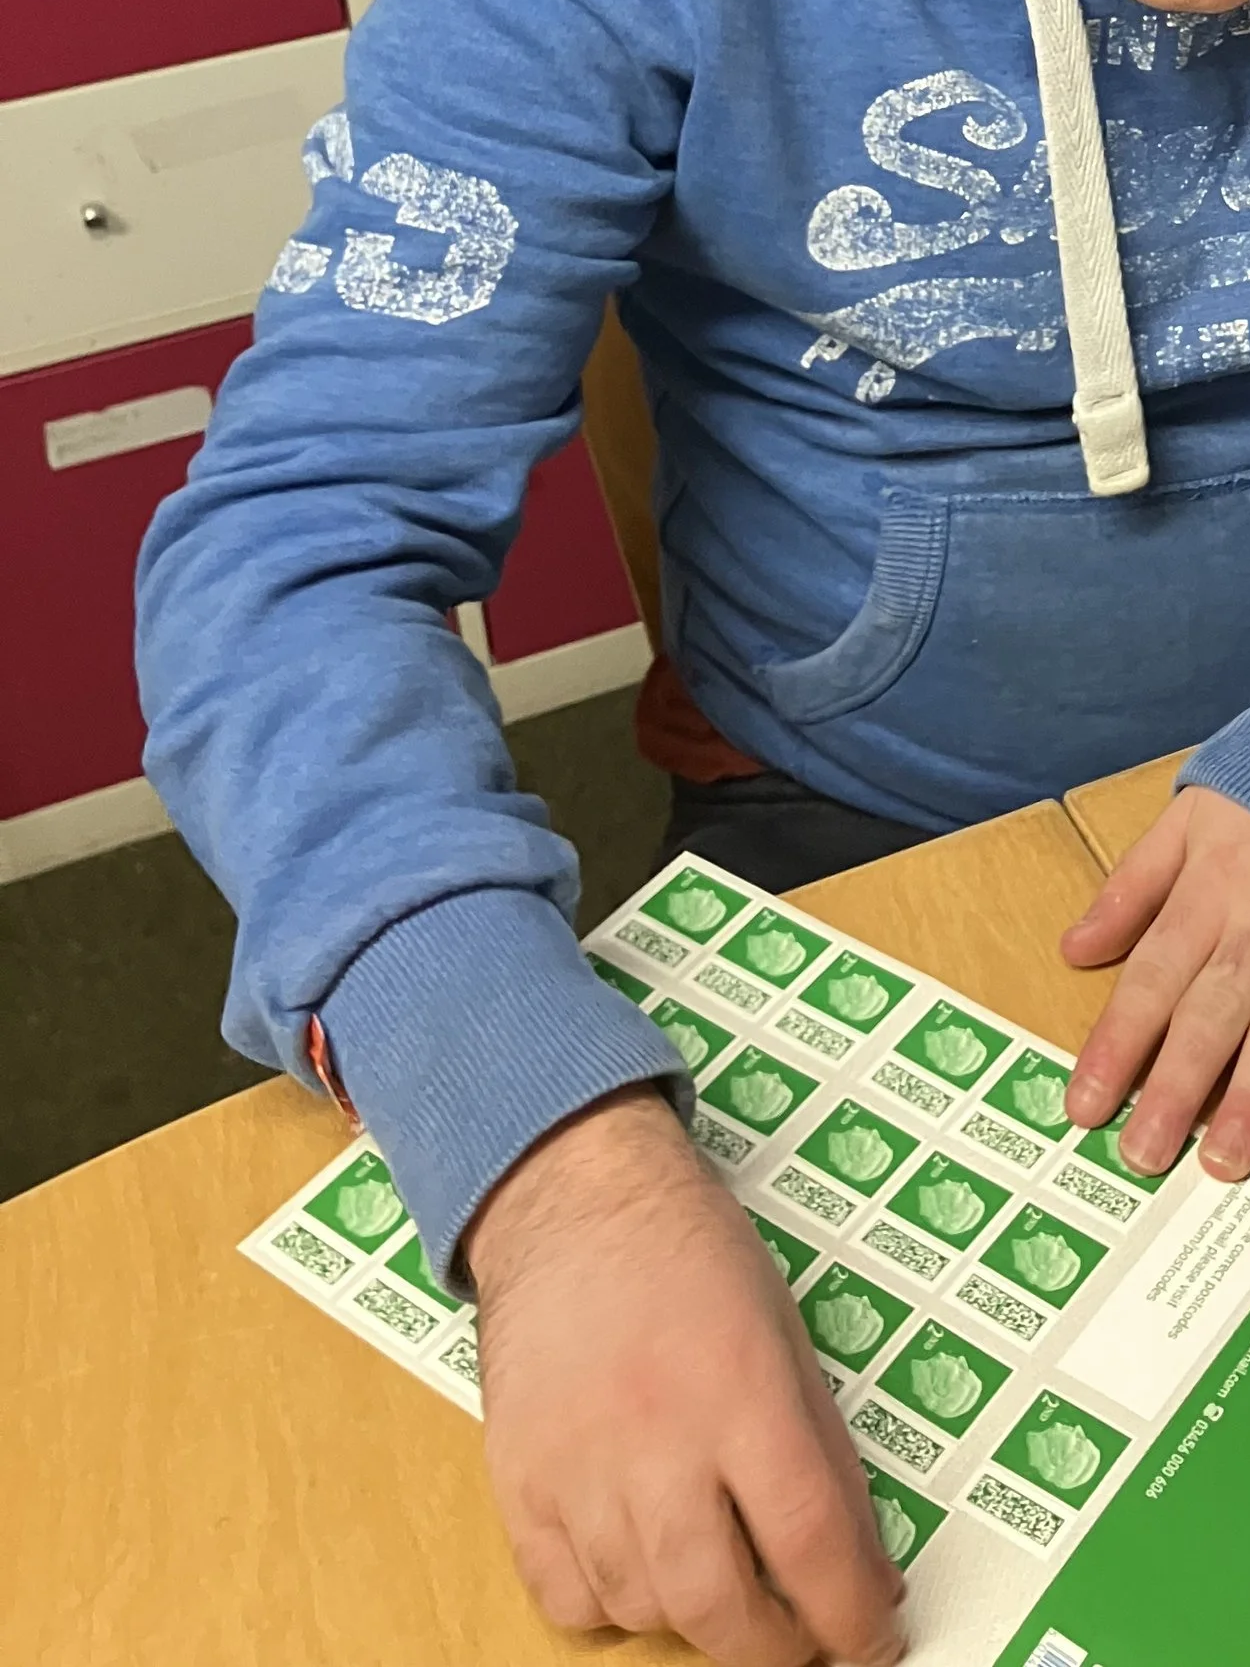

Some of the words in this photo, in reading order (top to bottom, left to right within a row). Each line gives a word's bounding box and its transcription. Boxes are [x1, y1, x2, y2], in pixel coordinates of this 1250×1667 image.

[1214, 1222, 1238, 1250] mail
[1190, 1244, 1219, 1284] please
[1212, 1244, 1245, 1283] correct
[1166, 1283, 1190, 1309] visit
[1168, 1280, 1216, 1340] postcodes
[1178, 1419, 1208, 1455] 03456
[1162, 1453, 1184, 1478] 000
[1145, 1475, 1168, 1499] 606
